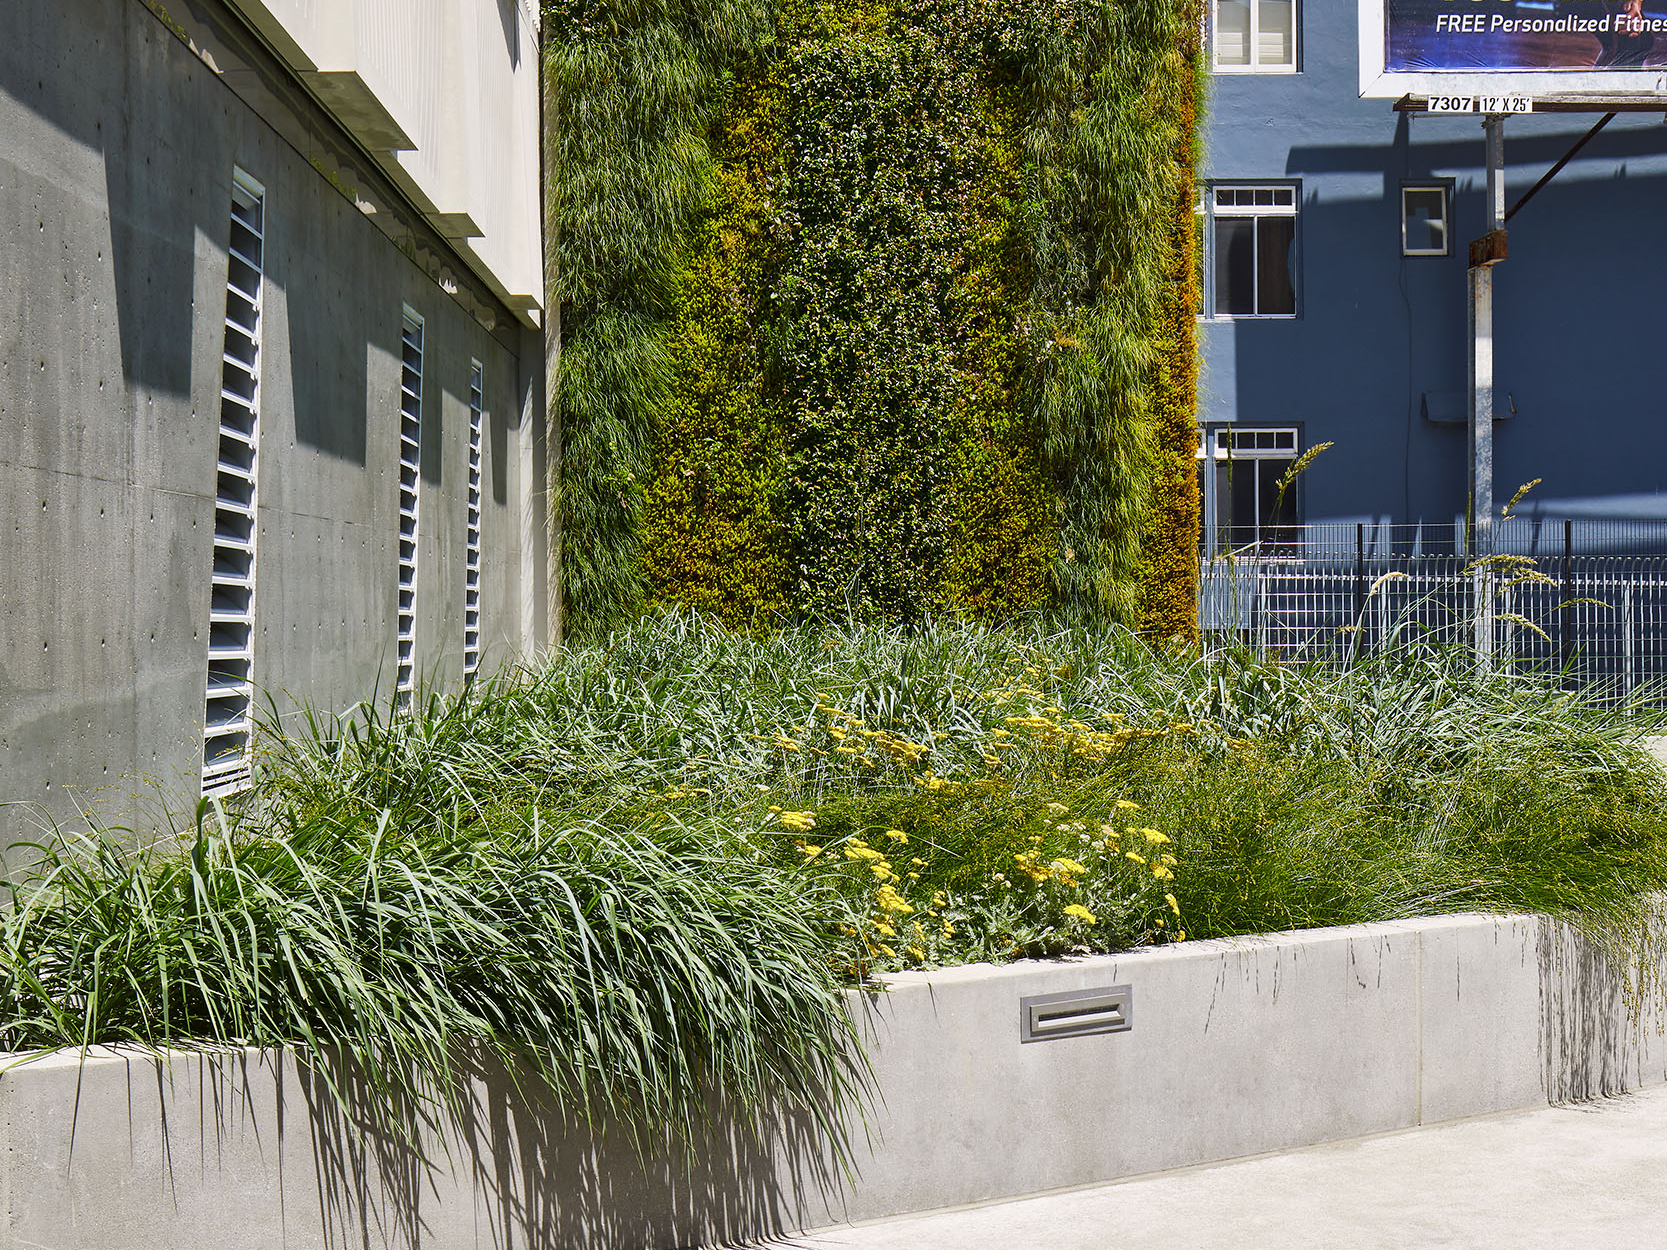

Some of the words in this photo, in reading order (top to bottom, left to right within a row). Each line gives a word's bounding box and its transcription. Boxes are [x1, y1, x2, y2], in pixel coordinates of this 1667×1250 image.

[1436, 14, 1487, 33] FREE
[1490, 14, 1610, 33] Personalized
[1430, 97, 1471, 110] 7307
[1483, 97, 1499, 111] 12'
[1502, 98, 1510, 111] X
[1512, 97, 1530, 111] 25'
